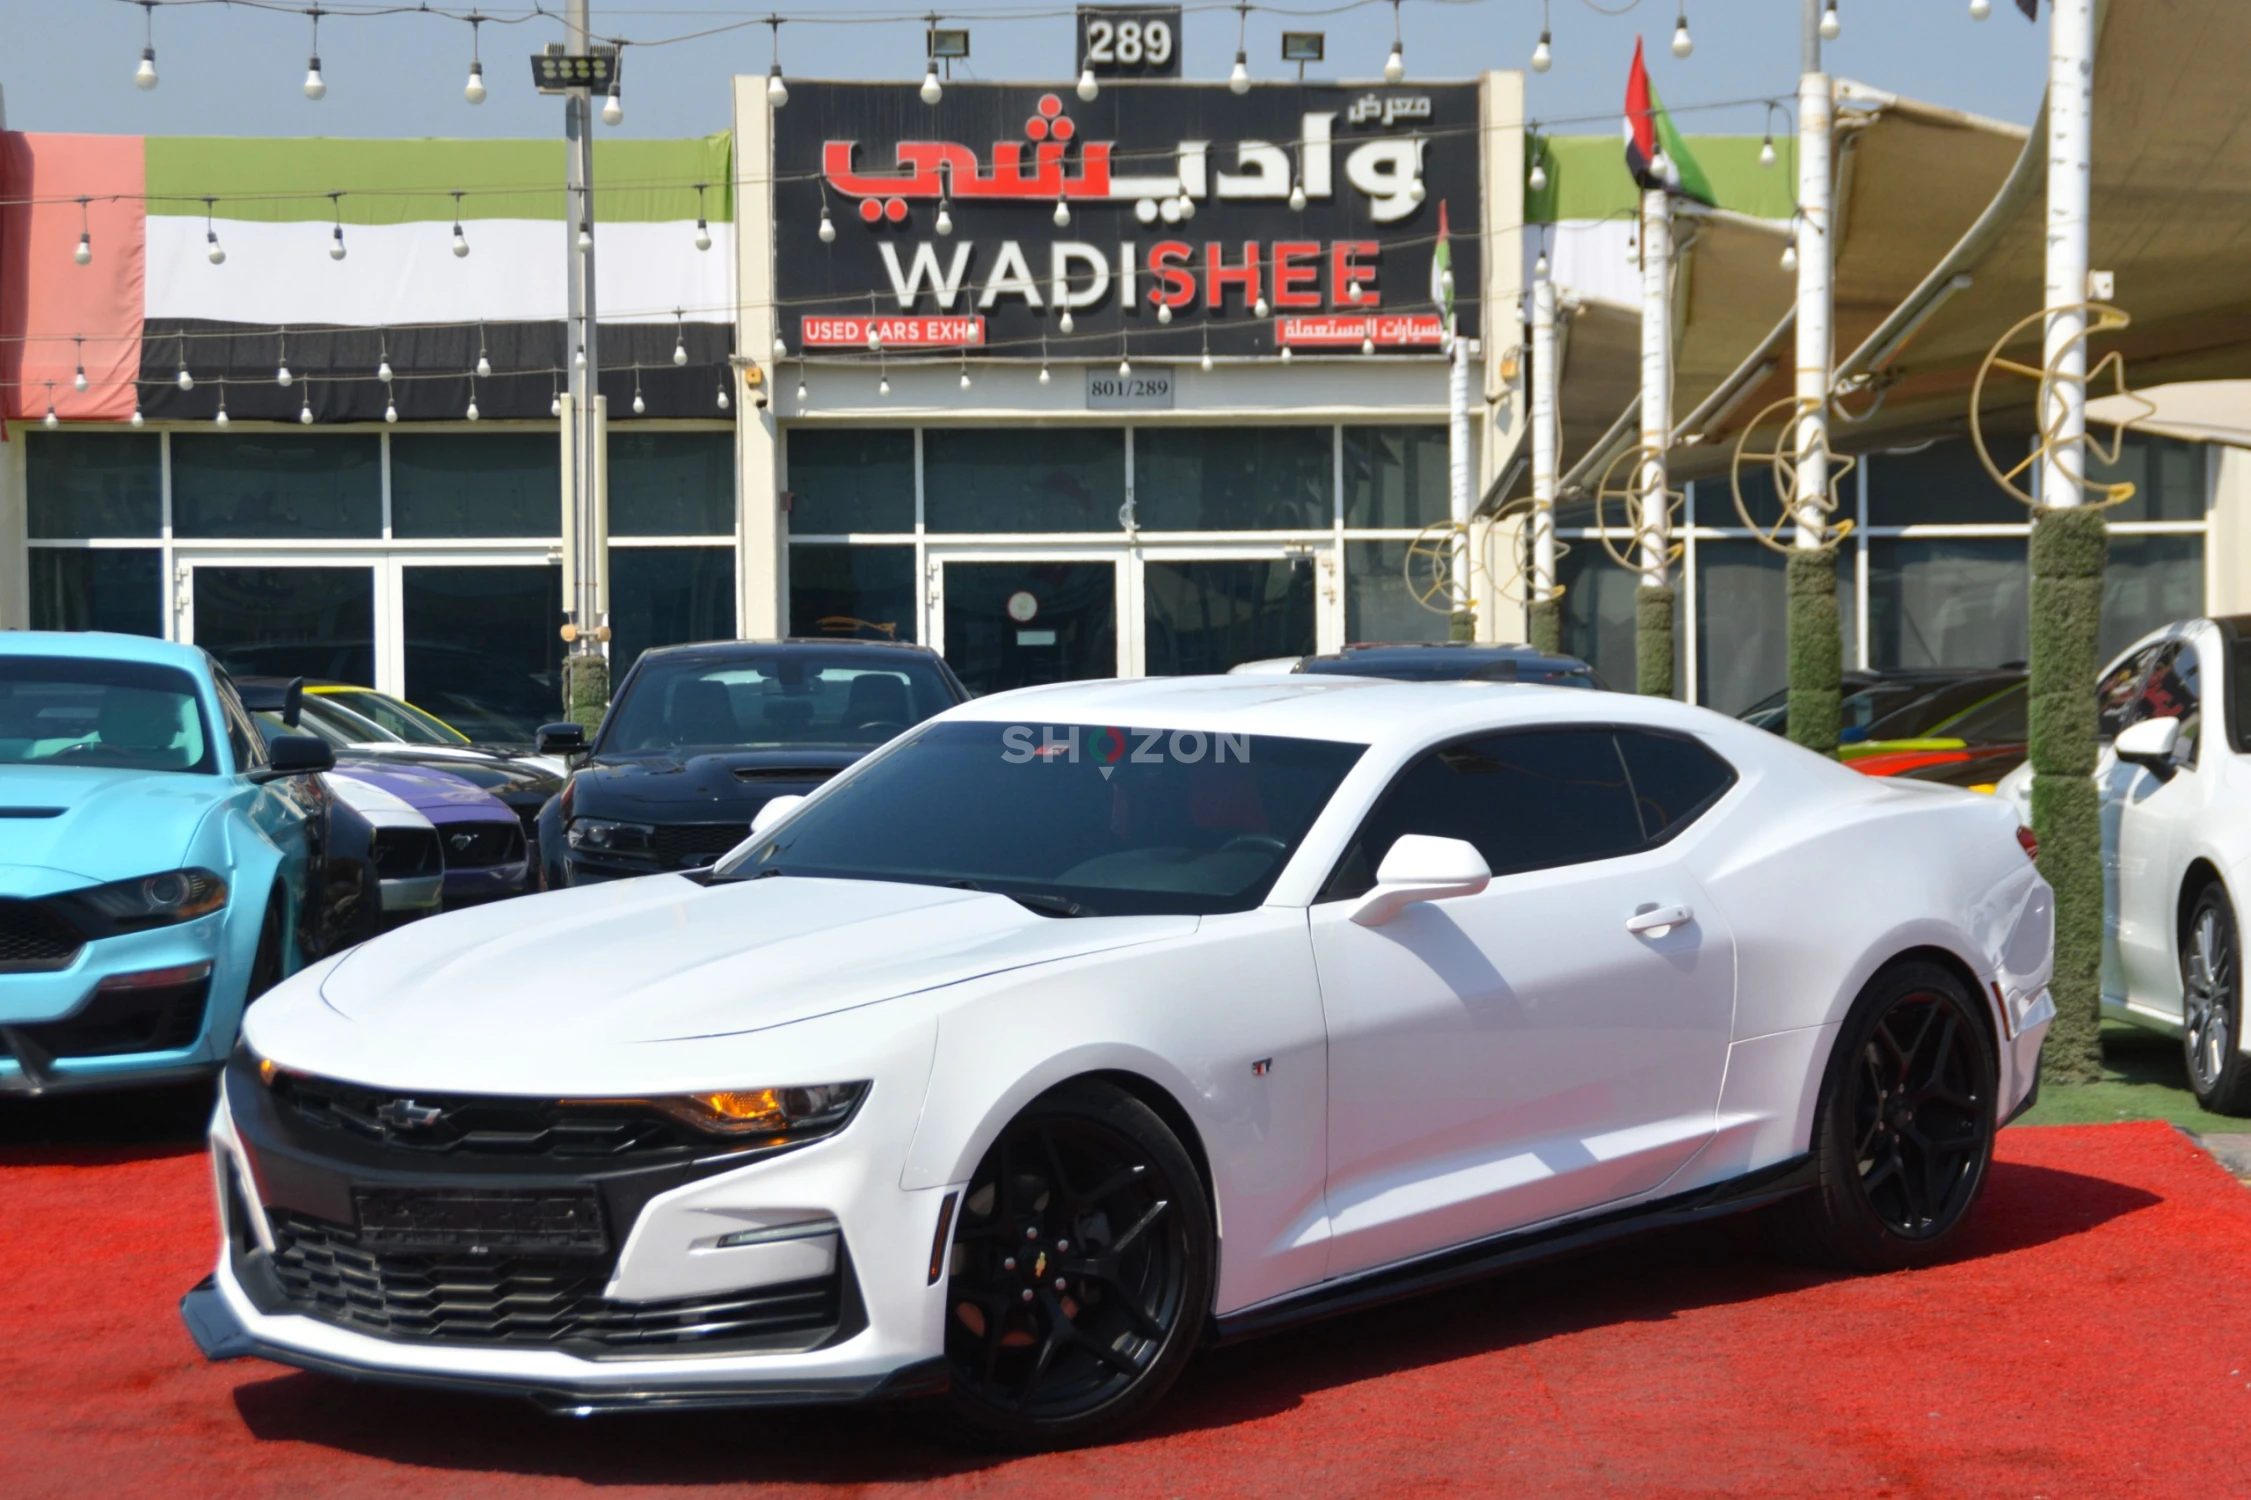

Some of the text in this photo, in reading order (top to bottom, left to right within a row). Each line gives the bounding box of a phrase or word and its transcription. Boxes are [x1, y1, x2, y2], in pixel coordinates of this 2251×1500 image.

[1089, 20, 1172, 64] 289
[1348, 93, 1431, 125] معرض
[878, 241, 1381, 308] WADISHEE
[806, 321, 859, 341] USED
[927, 320, 980, 341] EXH
[1091, 380, 1169, 396] 801/289
